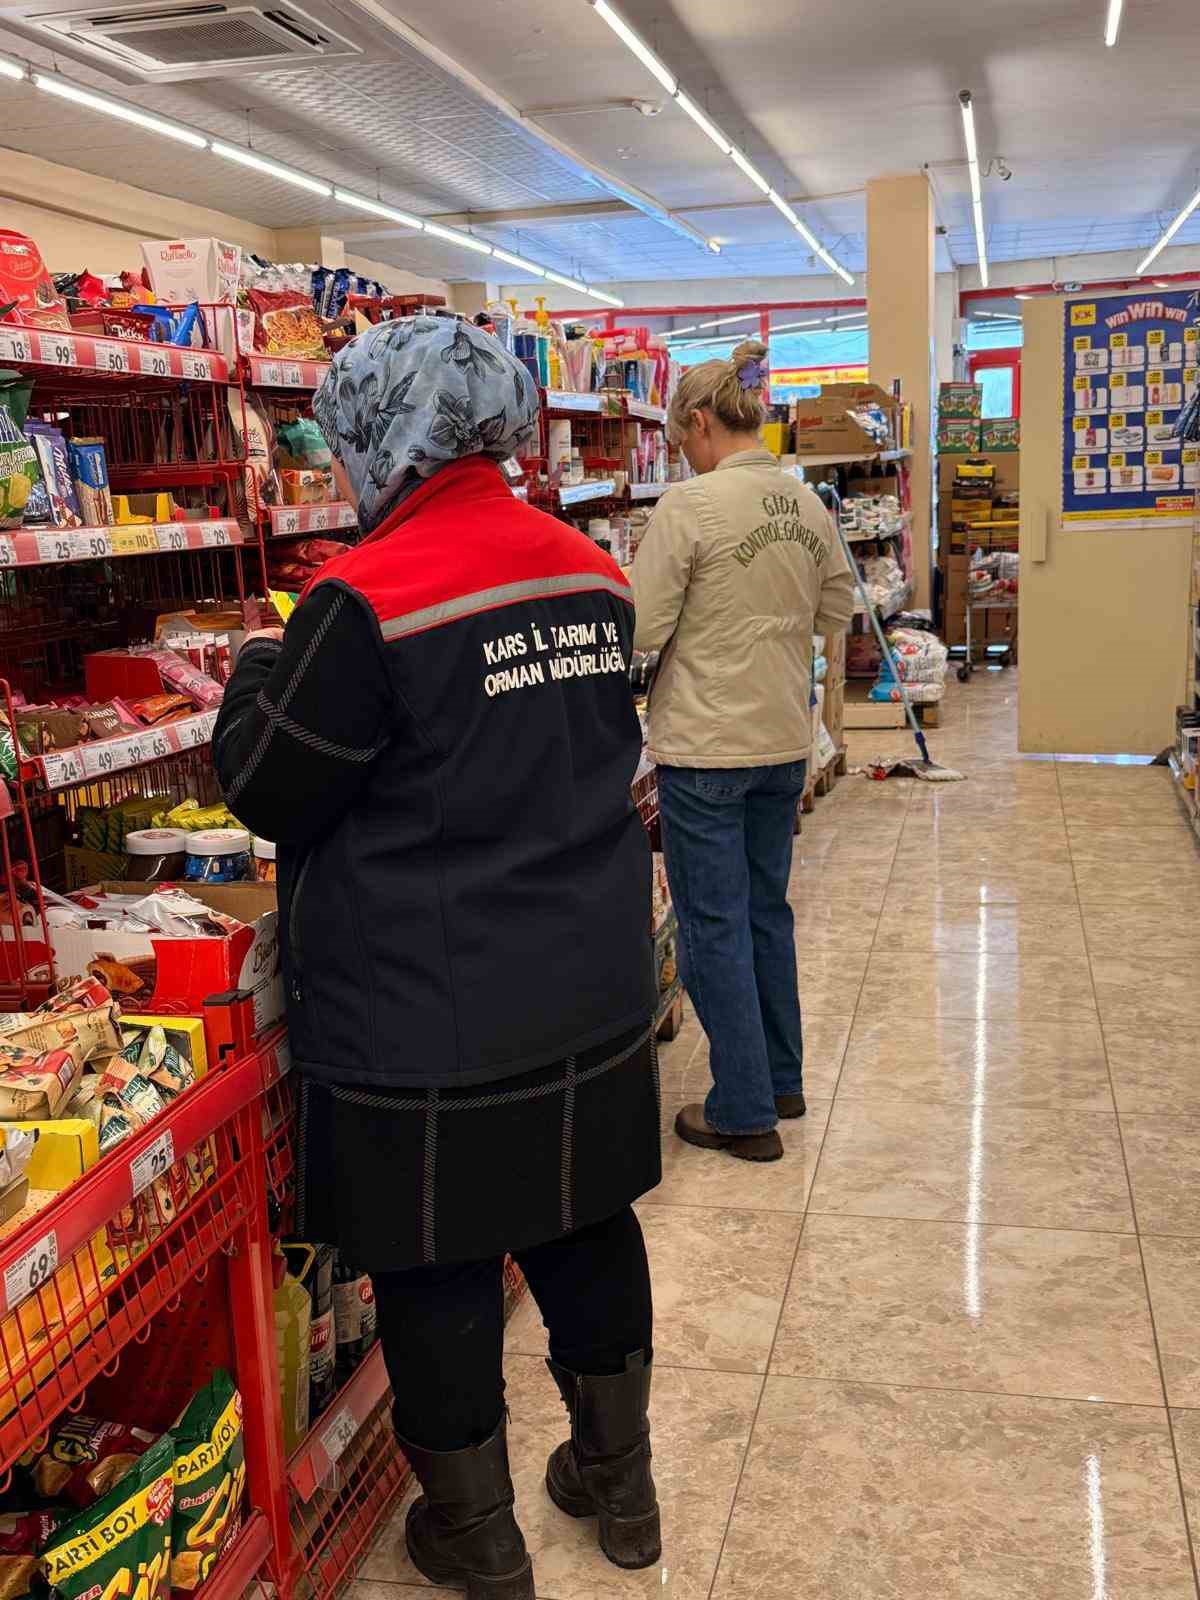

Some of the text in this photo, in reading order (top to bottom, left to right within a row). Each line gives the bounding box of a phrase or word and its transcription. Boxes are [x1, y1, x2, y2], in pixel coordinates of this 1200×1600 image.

[11, 341, 25, 360] 13
[55, 346, 70, 364] 99
[108, 354, 123, 370] 50
[152, 358, 166, 375] 20
[193, 363, 206, 379] 50
[56, 541, 70, 559] 25
[90, 538, 106, 555] 50
[169, 533, 182, 549] 20
[483, 633, 527, 666] KARS
[531, 622, 549, 652] İL
[551, 622, 597, 649] TARIM
[484, 662, 545, 698] ORMAN
[61, 761, 77, 782] 24
[29, 1253, 48, 1288] 69
[98, 1505, 138, 1544] BOY
